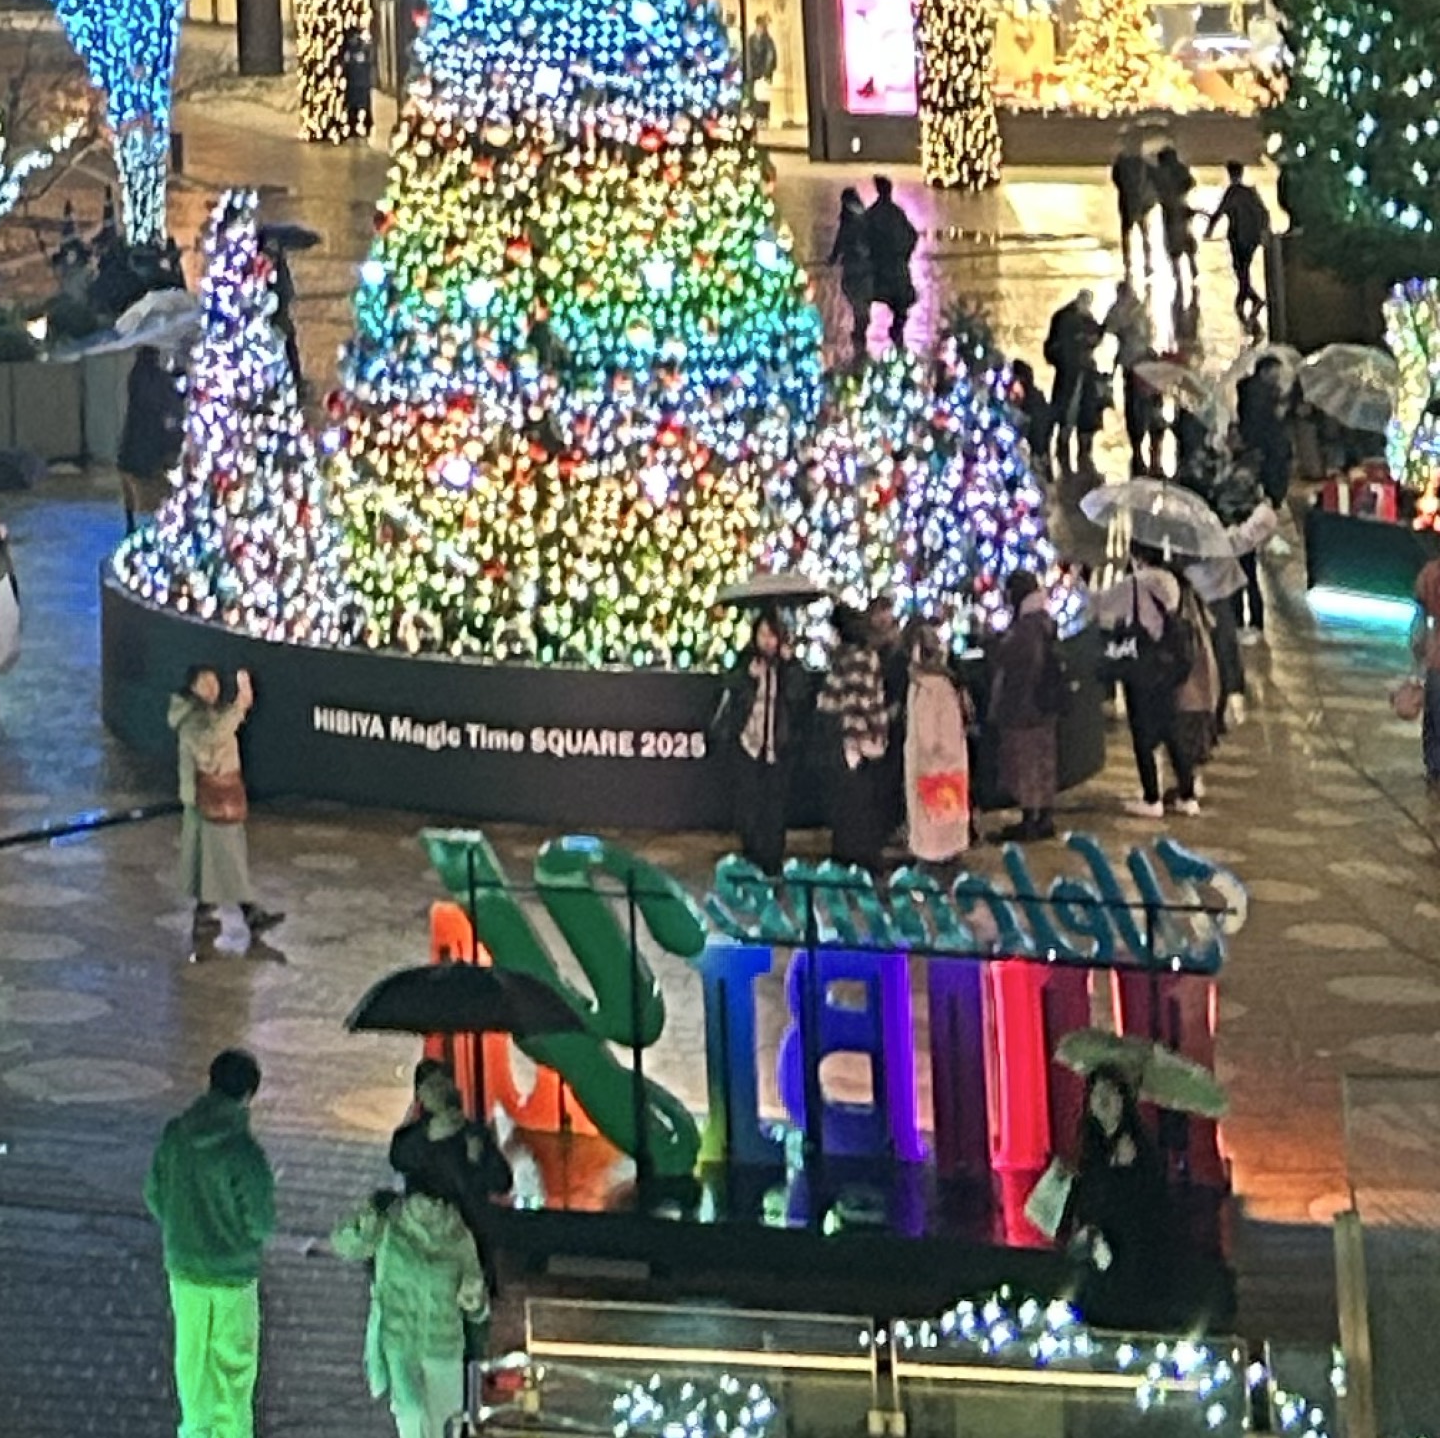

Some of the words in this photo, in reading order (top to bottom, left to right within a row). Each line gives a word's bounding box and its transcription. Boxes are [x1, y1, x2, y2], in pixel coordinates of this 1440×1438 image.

[313, 706, 385, 739] HIBIYA
[390, 716, 461, 751] Magic
[465, 721, 524, 753] Time
[529, 726, 635, 759] SQUARE
